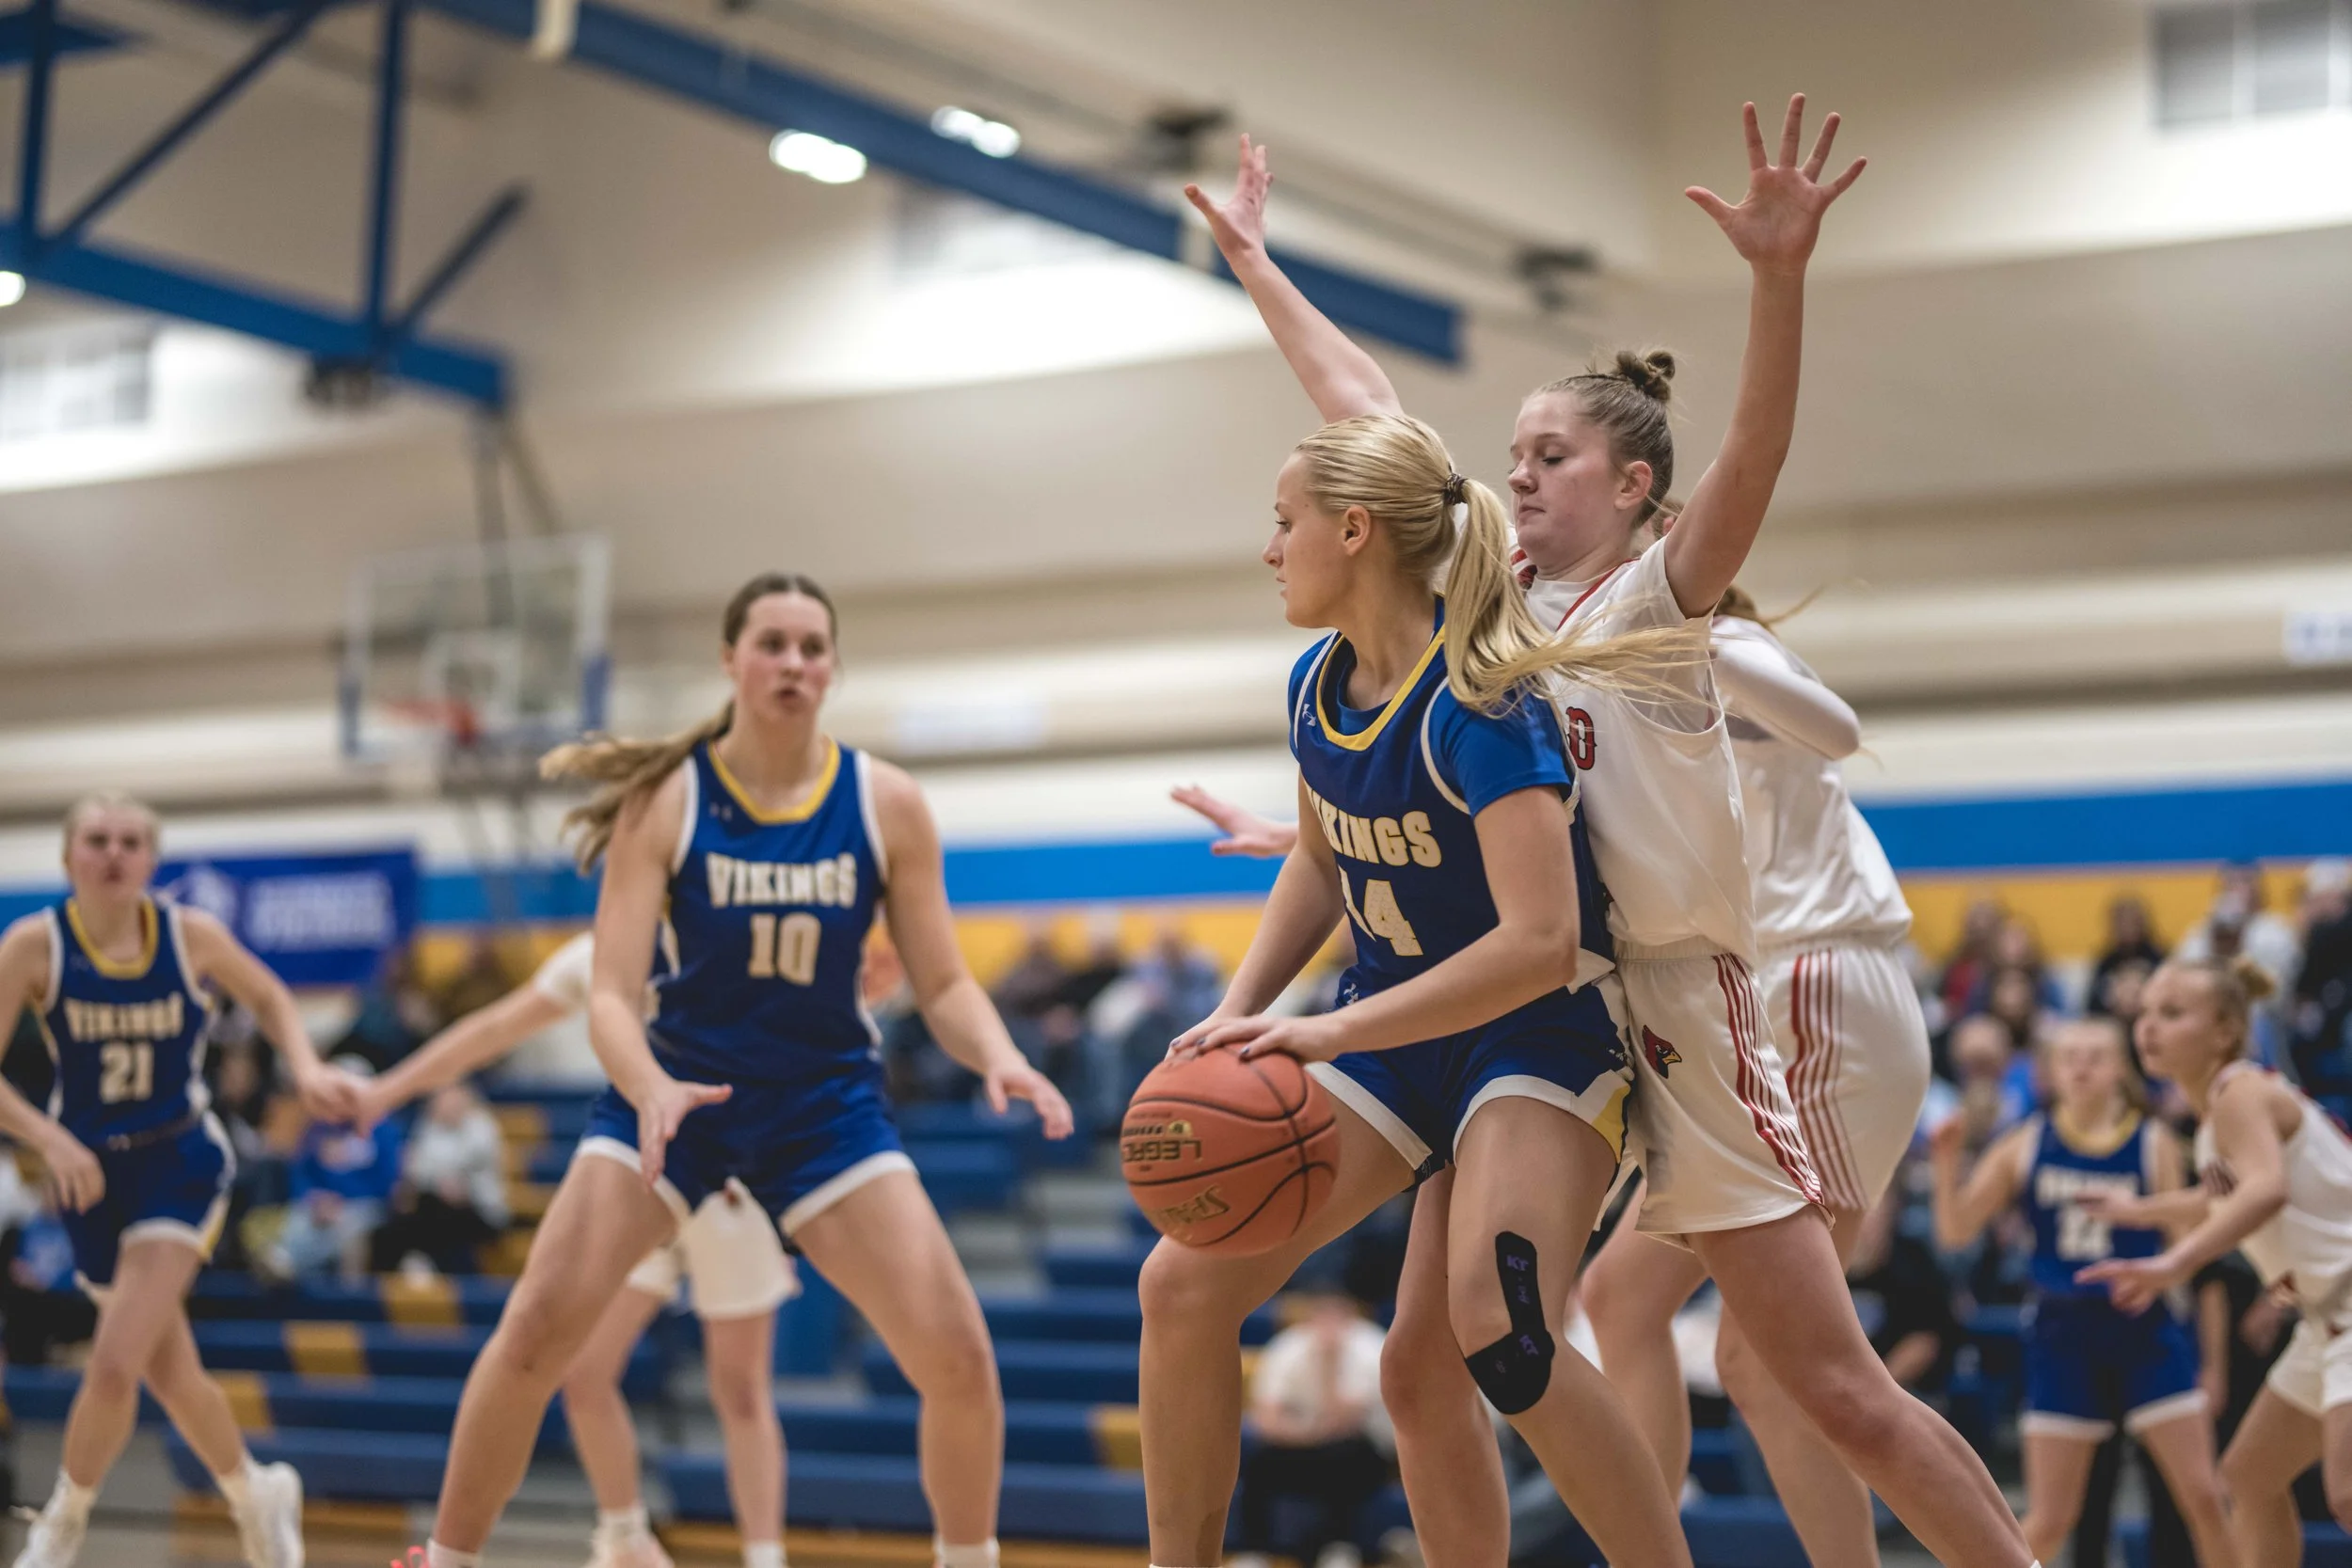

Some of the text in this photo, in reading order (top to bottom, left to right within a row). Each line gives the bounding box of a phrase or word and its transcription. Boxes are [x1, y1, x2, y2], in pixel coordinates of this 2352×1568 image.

[1303, 779, 1442, 868] IKINGS
[706, 850, 858, 910] VIKINGS
[747, 912, 821, 986] 10
[99, 1040, 155, 1104] 21
